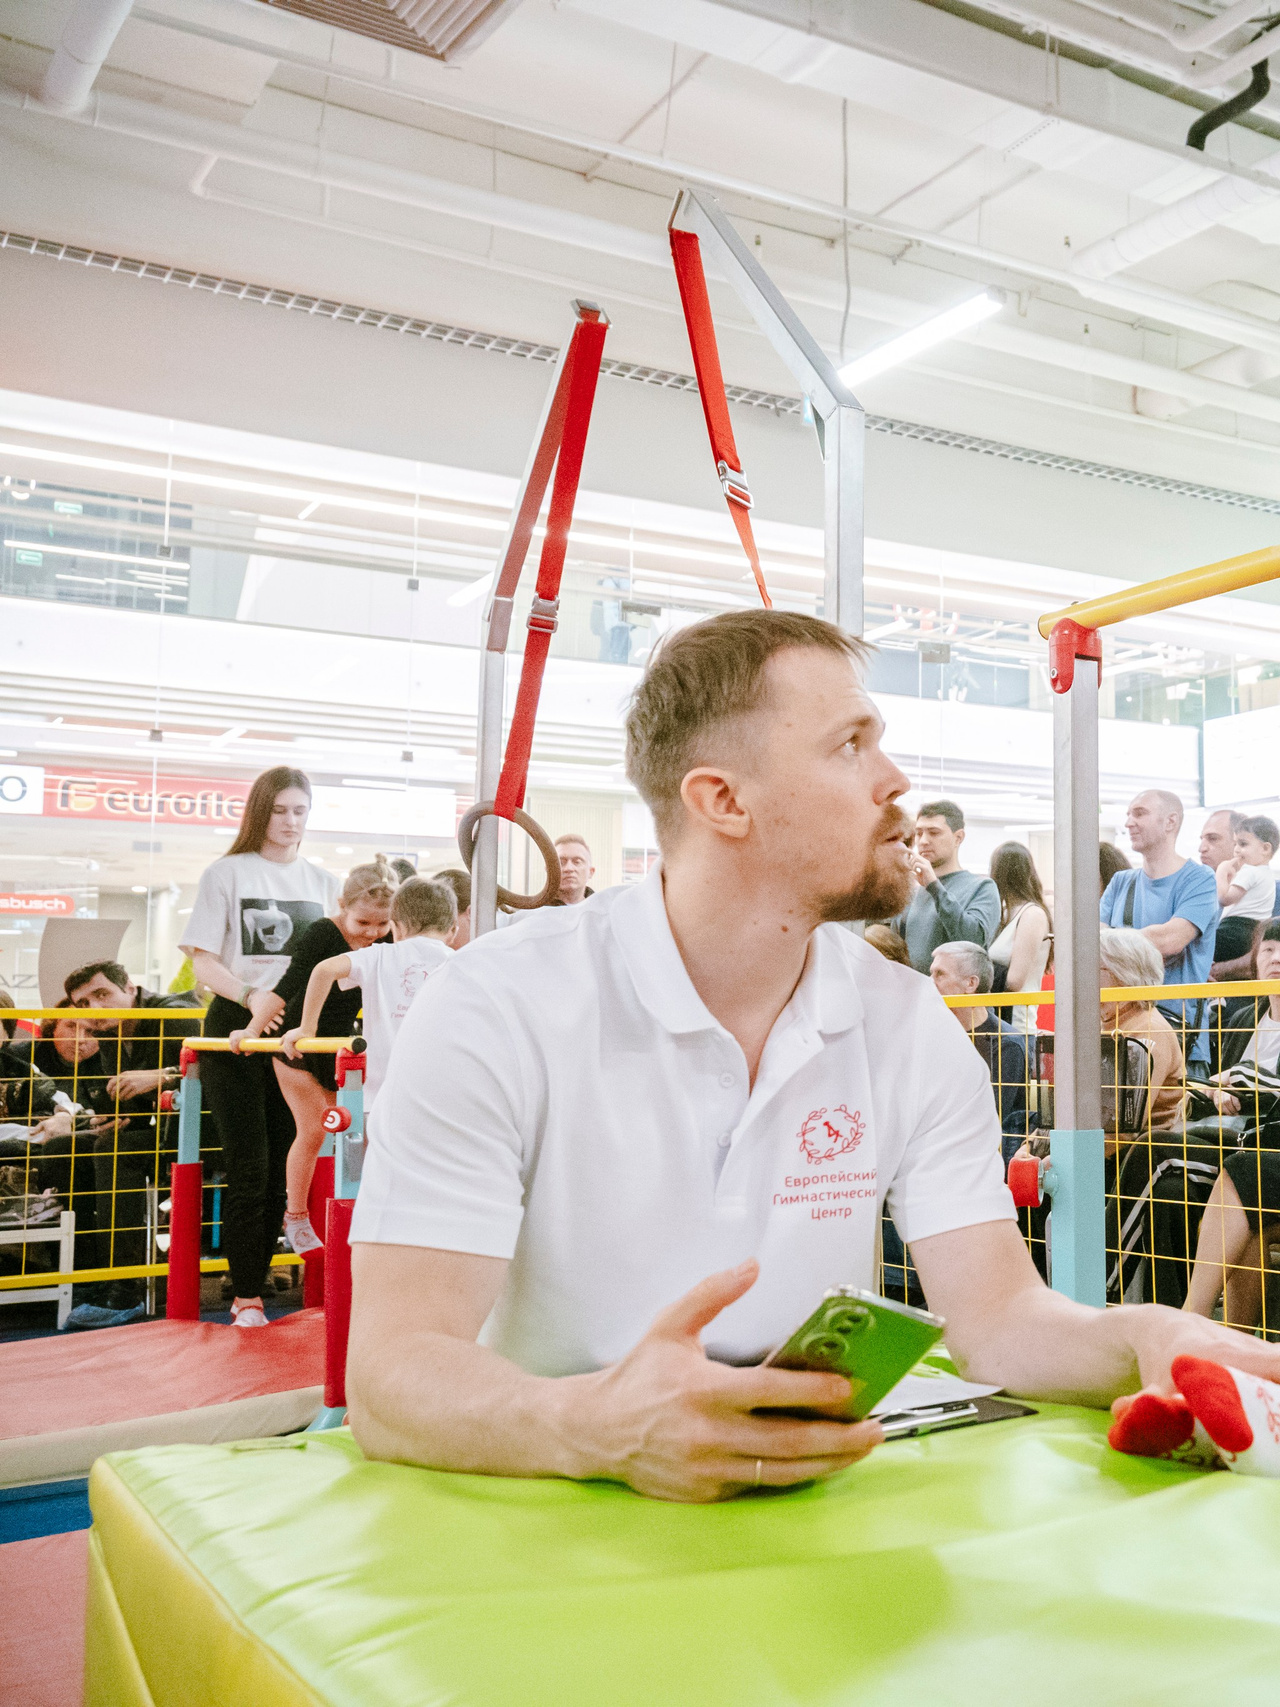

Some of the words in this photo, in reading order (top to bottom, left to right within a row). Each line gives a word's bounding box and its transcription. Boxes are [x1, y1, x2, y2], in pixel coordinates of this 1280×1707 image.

[103, 787, 246, 821] eurofle
[784, 1168, 877, 1188] Европейский
[773, 1188, 877, 1205] Гимнастическ
[811, 1207, 853, 1221] Центр
